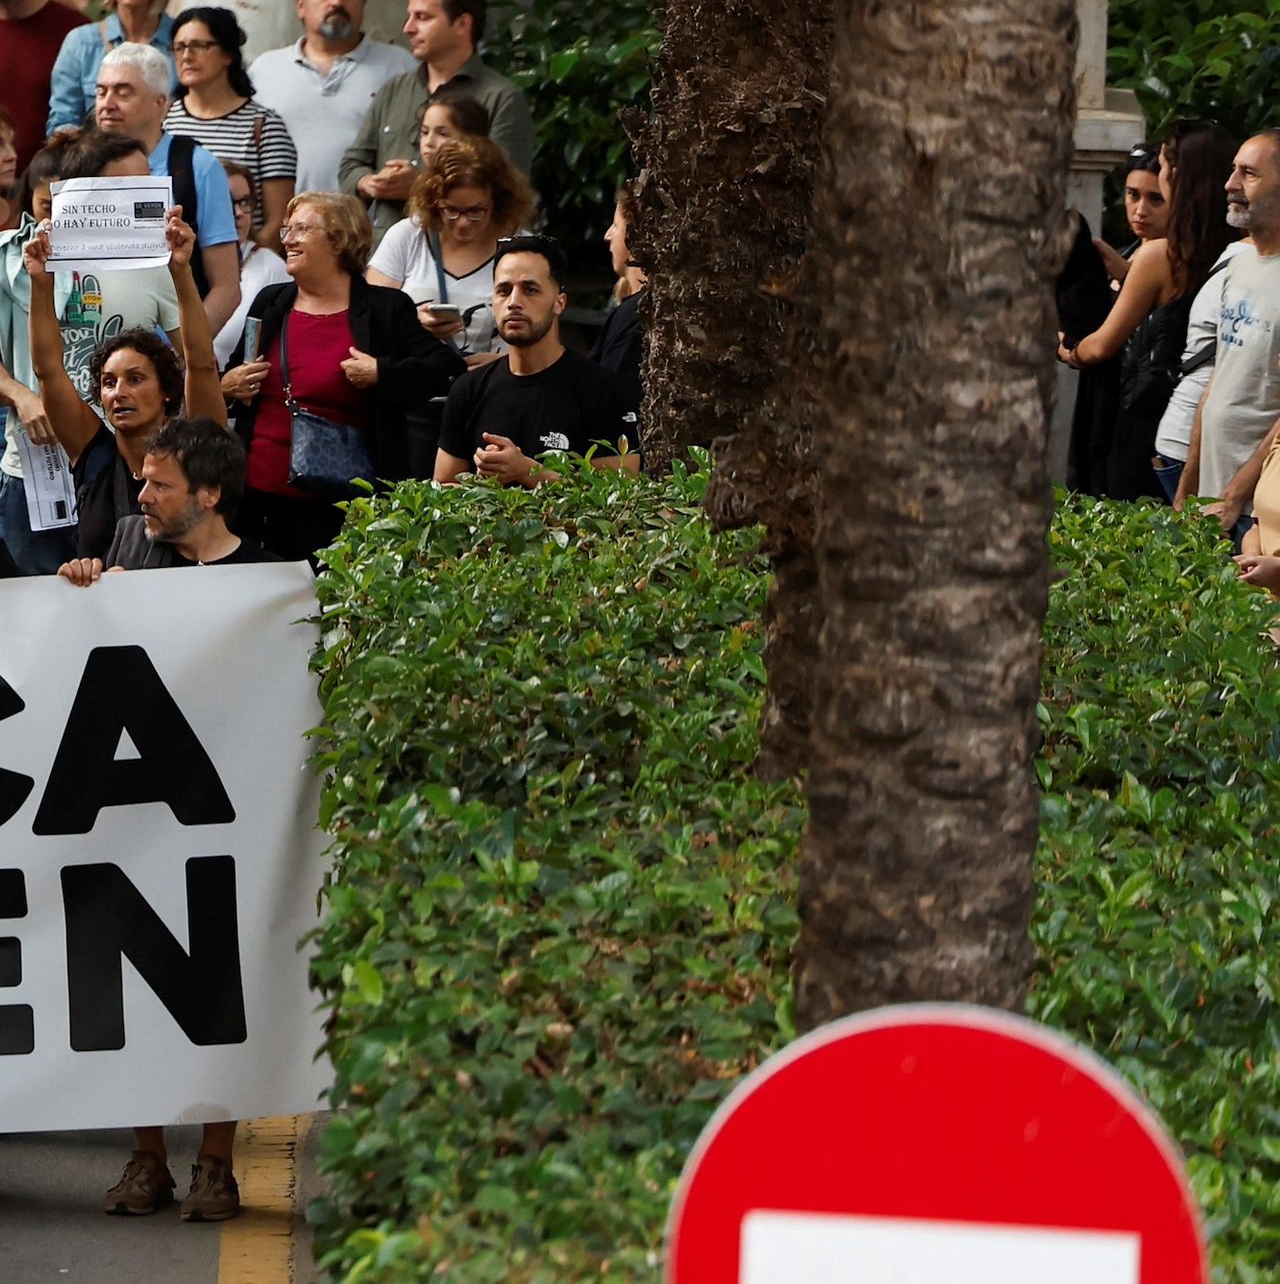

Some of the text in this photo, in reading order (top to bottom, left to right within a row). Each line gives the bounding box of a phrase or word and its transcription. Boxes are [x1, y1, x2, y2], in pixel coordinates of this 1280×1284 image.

[62, 204, 117, 214] SIN TECHO
[53, 219, 61, 229] O
[63, 218, 88, 229] HAY
[89, 218, 131, 228] FUTURO
